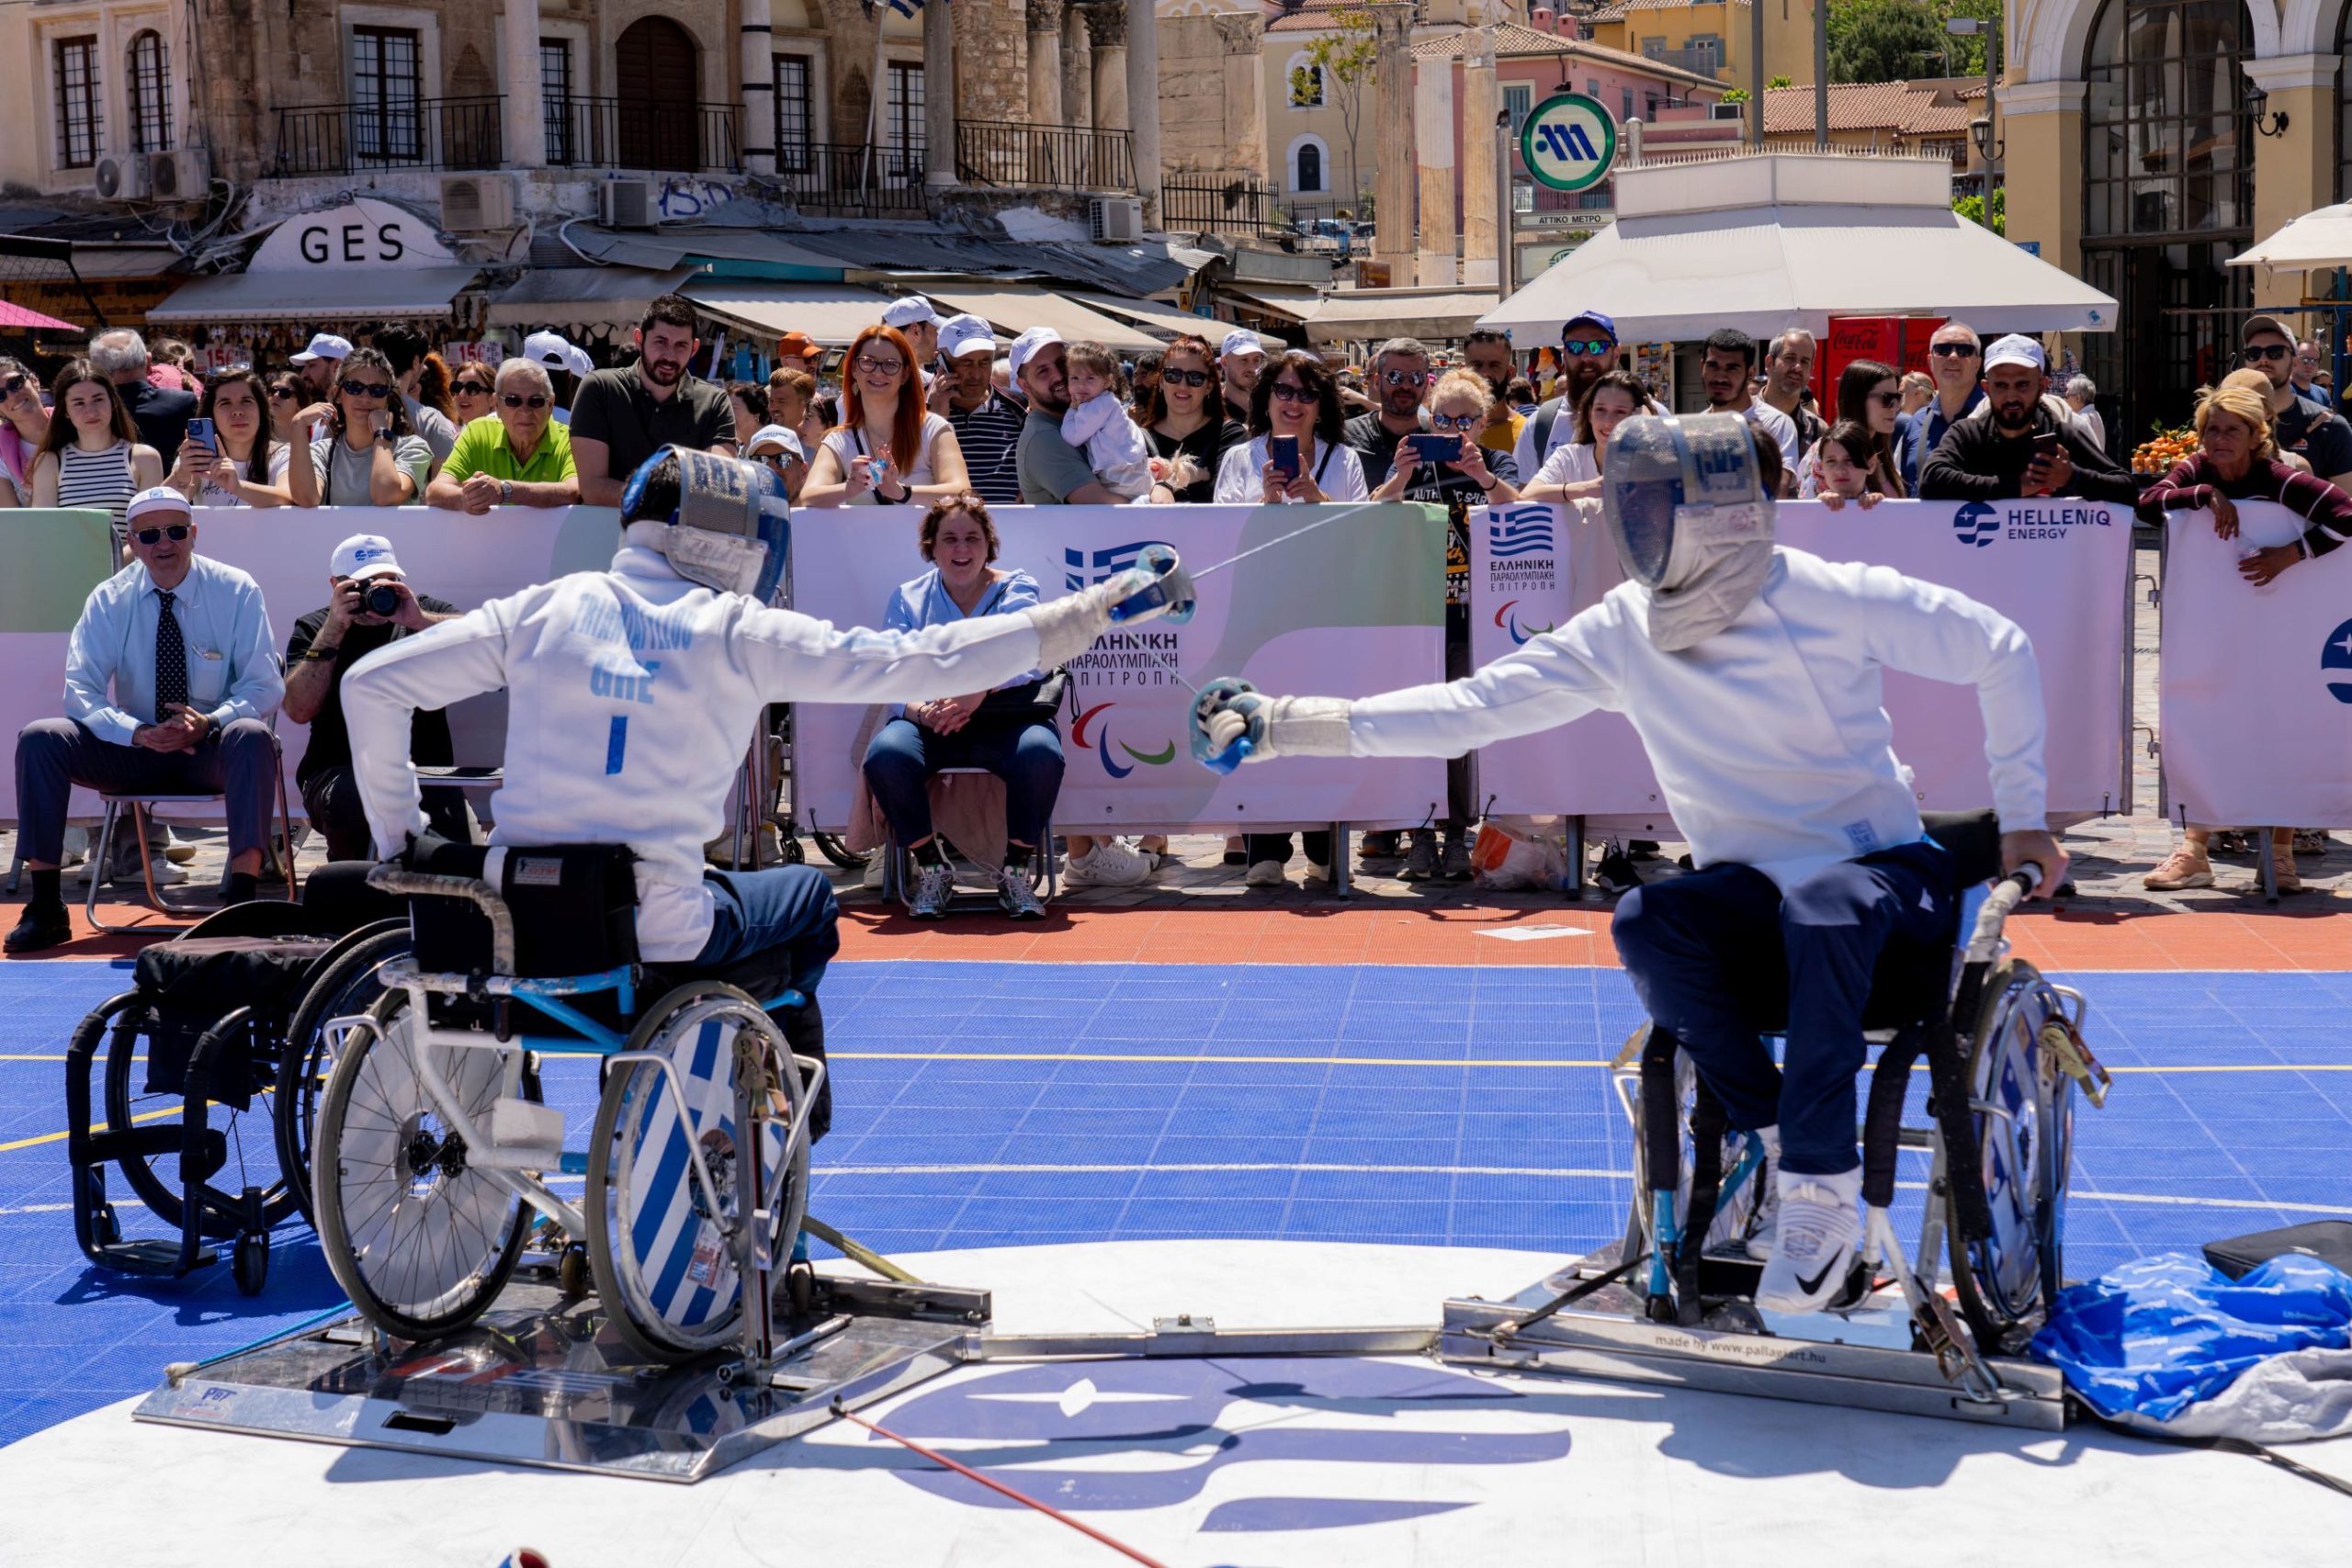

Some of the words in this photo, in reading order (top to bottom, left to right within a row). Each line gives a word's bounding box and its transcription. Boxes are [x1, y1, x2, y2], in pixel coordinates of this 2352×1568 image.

[1539, 216, 1568, 224] ΑΤΤΙΚΟ
[1572, 215, 1600, 223] ΜΕΤΡΟ
[300, 223, 403, 264] GES
[2008, 509, 2111, 526] HELLENiQ
[2008, 528, 2067, 539] ENERGY
[1490, 559, 1554, 571] ΕΛΛΗΝΙΚΗ
[1490, 570, 1555, 581] ΠΑΡΑΟΛΥΜΠΙΑΚΗ
[1490, 581, 1555, 592] ΕΠΙΤΡΟΠΗ
[1089, 634, 1178, 650] ΛΗΝΙΚΗ
[1655, 1335, 1690, 1348] made
[1693, 1338, 1707, 1353] by
